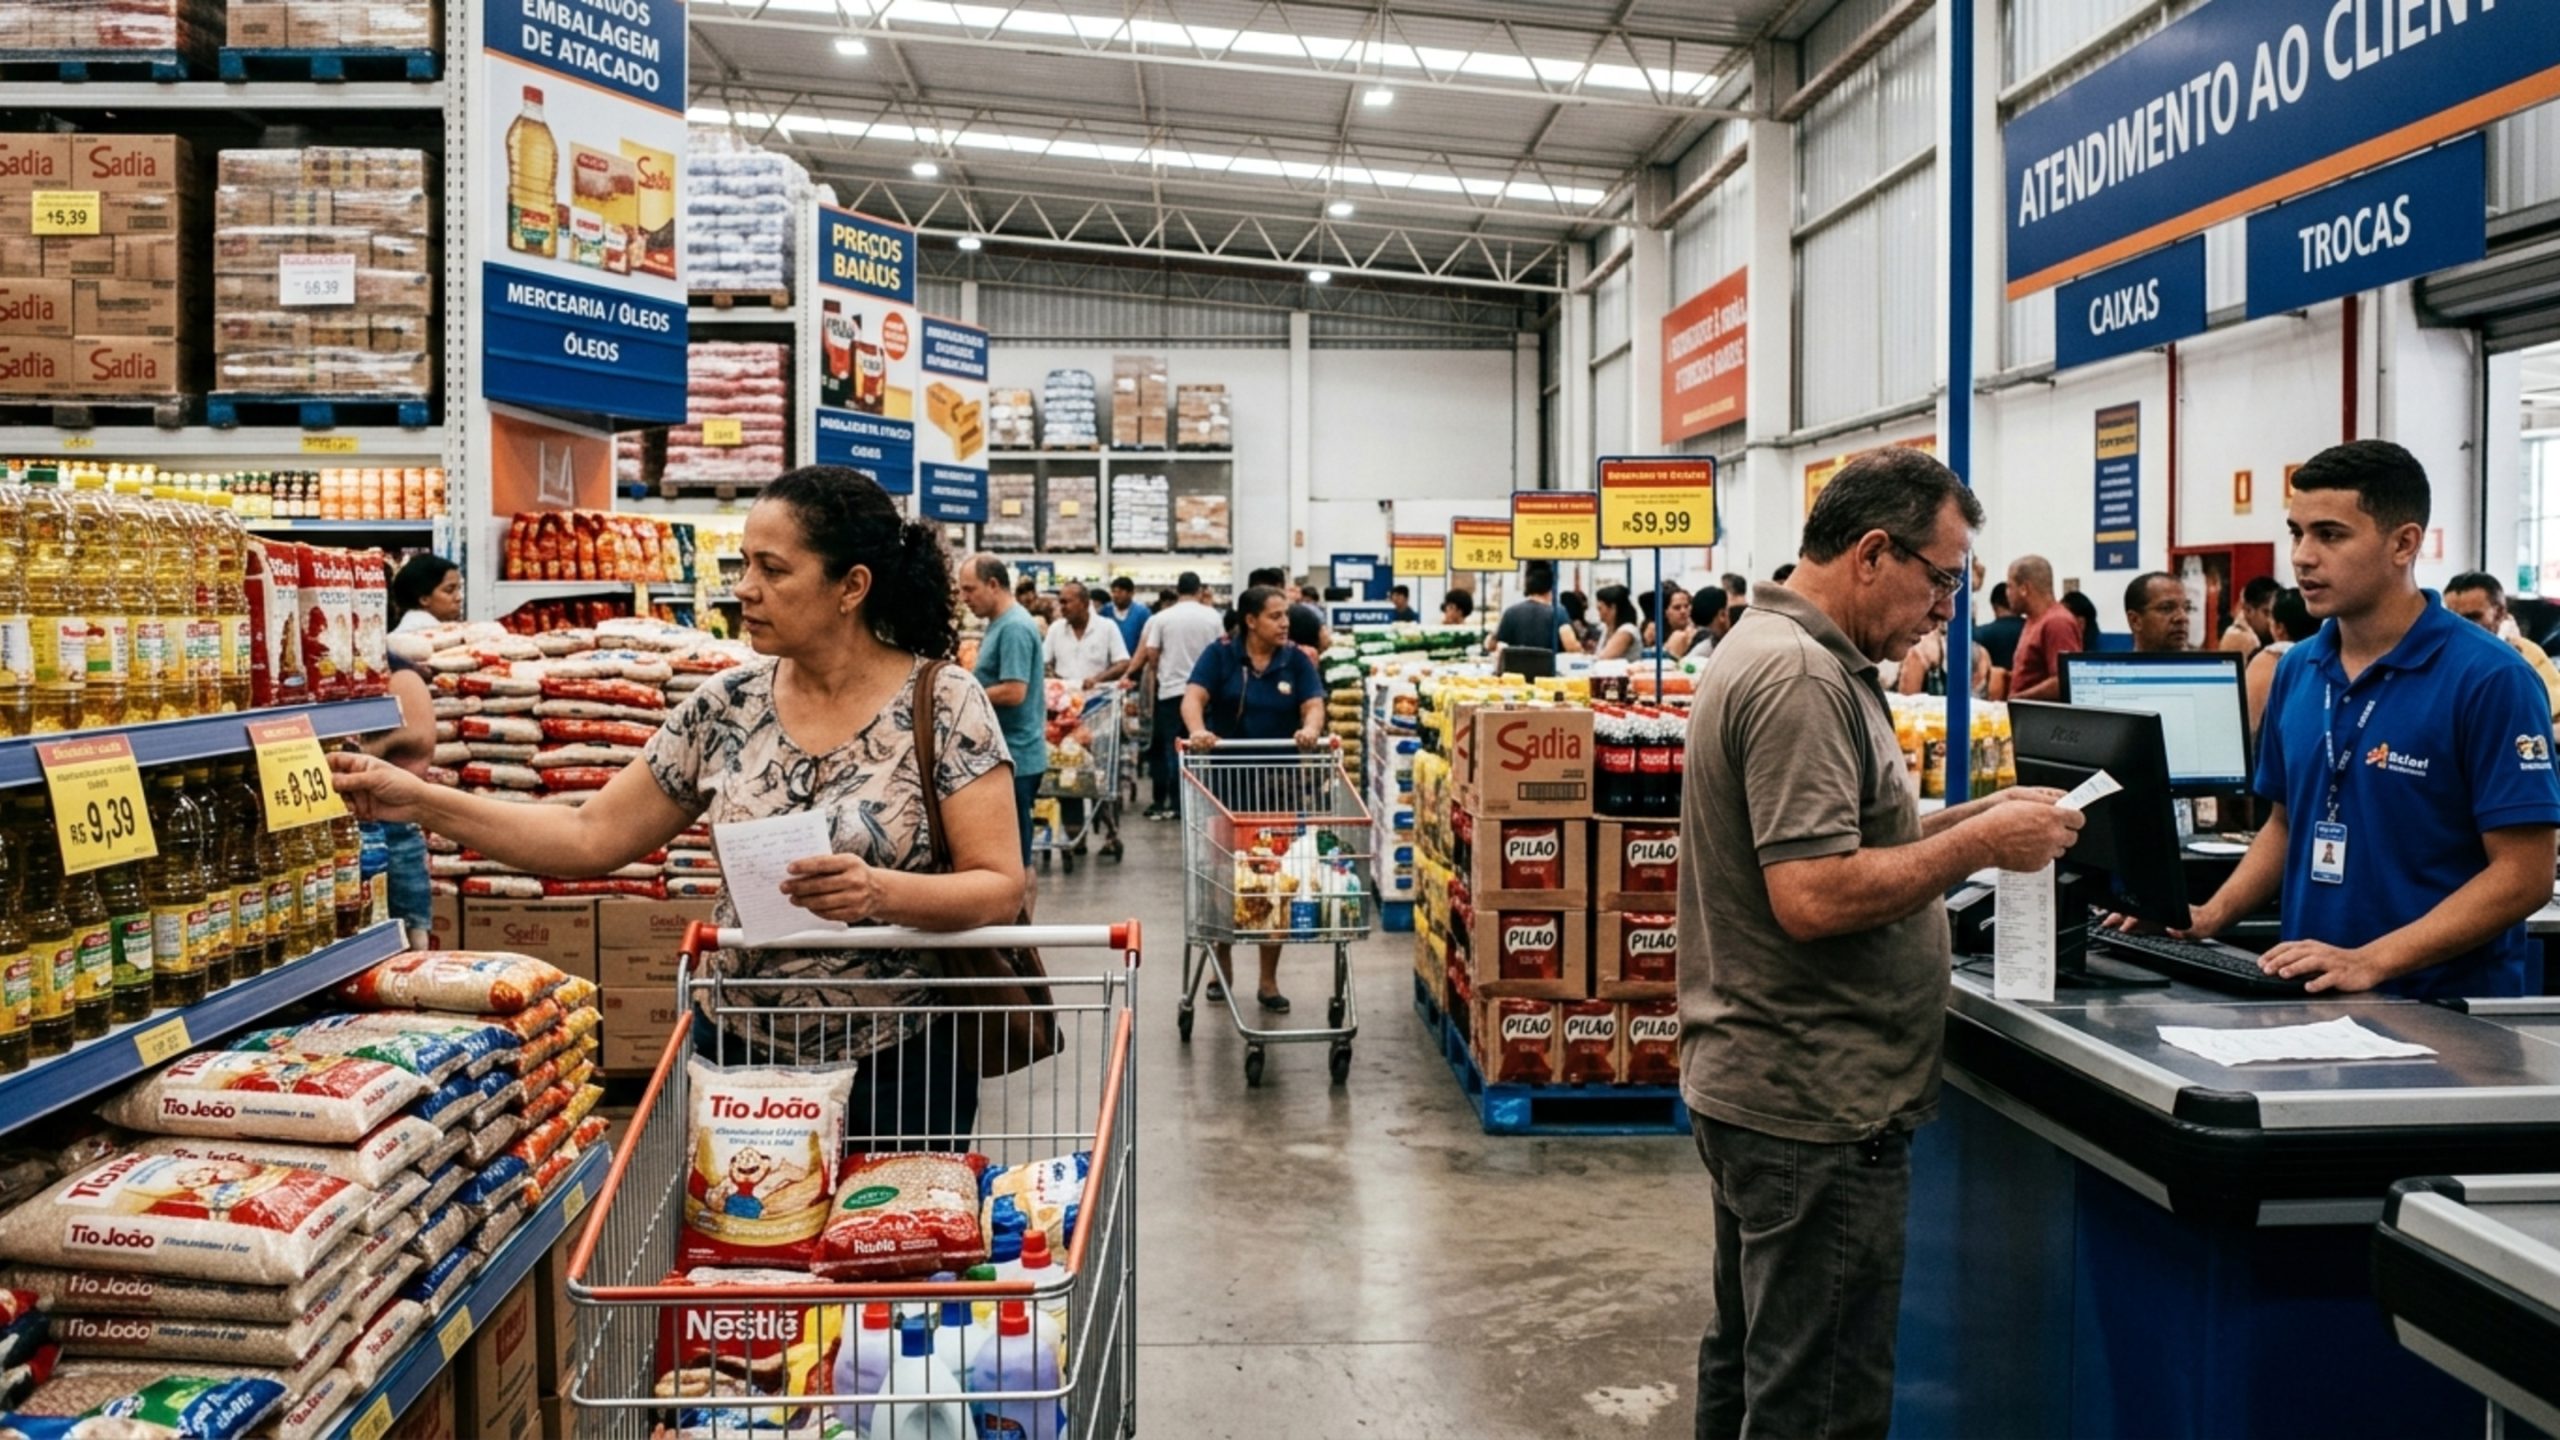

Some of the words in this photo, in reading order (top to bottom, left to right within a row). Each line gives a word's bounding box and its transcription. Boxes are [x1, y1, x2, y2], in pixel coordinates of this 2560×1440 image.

[522, 0, 660, 62] EMBALAGEM
[522, 24, 553, 57] DE
[558, 38, 660, 92] ATACADO
[2018, 61, 2239, 228] ATENDIMENTO
[2247, 24, 2310, 122] AO
[89, 145, 156, 178] Sadia
[2299, 194, 2412, 272] TROCAS
[507, 282, 606, 321] MERCEARIA
[608, 303, 616, 323] /
[2089, 278, 2161, 336] CAIXAS
[90, 348, 157, 381] Sadia
[563, 331, 620, 363] ÓLEOS
[1497, 721, 1581, 771] Sadia
[87, 796, 135, 850] 9,39
[163, 1098, 188, 1115] Tio
[710, 1095, 750, 1119] Tio
[752, 1096, 821, 1120] João
[72, 1224, 100, 1244] Tio
